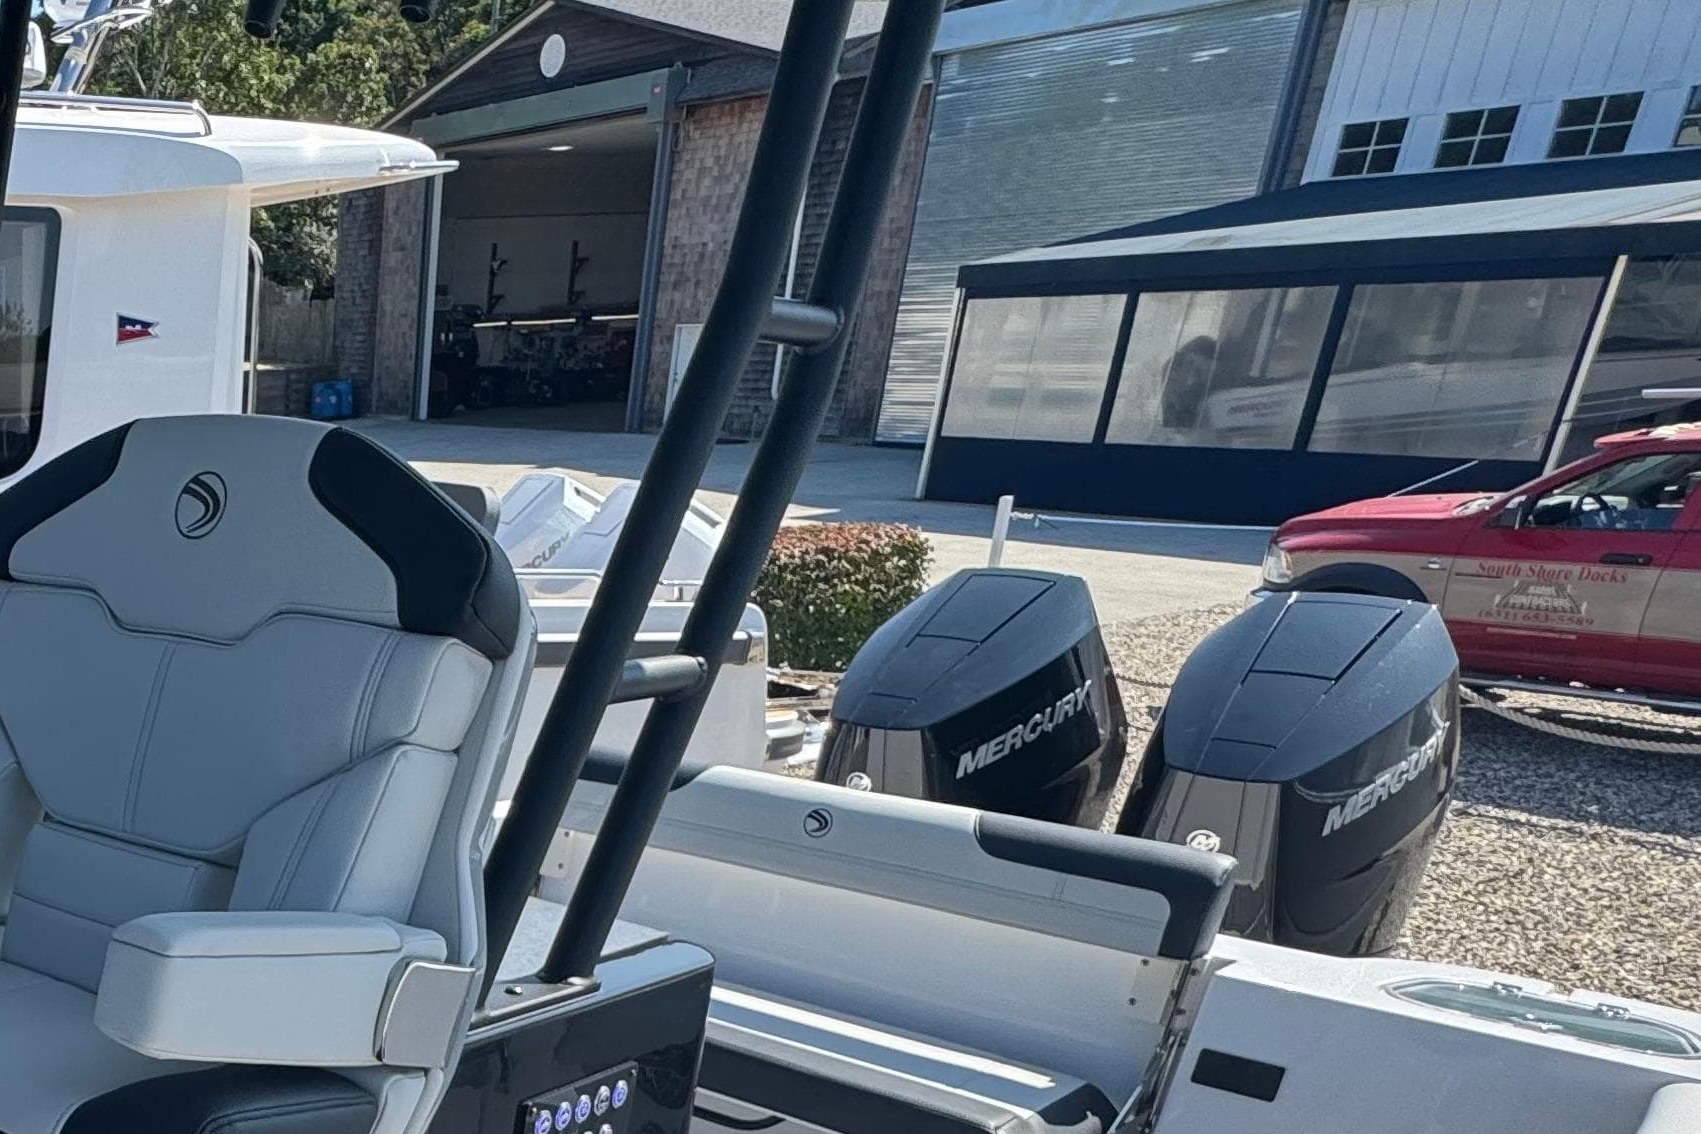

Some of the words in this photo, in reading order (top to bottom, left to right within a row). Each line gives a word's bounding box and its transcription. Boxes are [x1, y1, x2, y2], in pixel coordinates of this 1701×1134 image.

[1476, 561, 1522, 577] South
[1526, 564, 1574, 581] Shore
[1577, 566, 1629, 584] Docks
[955, 679, 1093, 780] MERCURY
[1322, 720, 1451, 837] MERCURY
